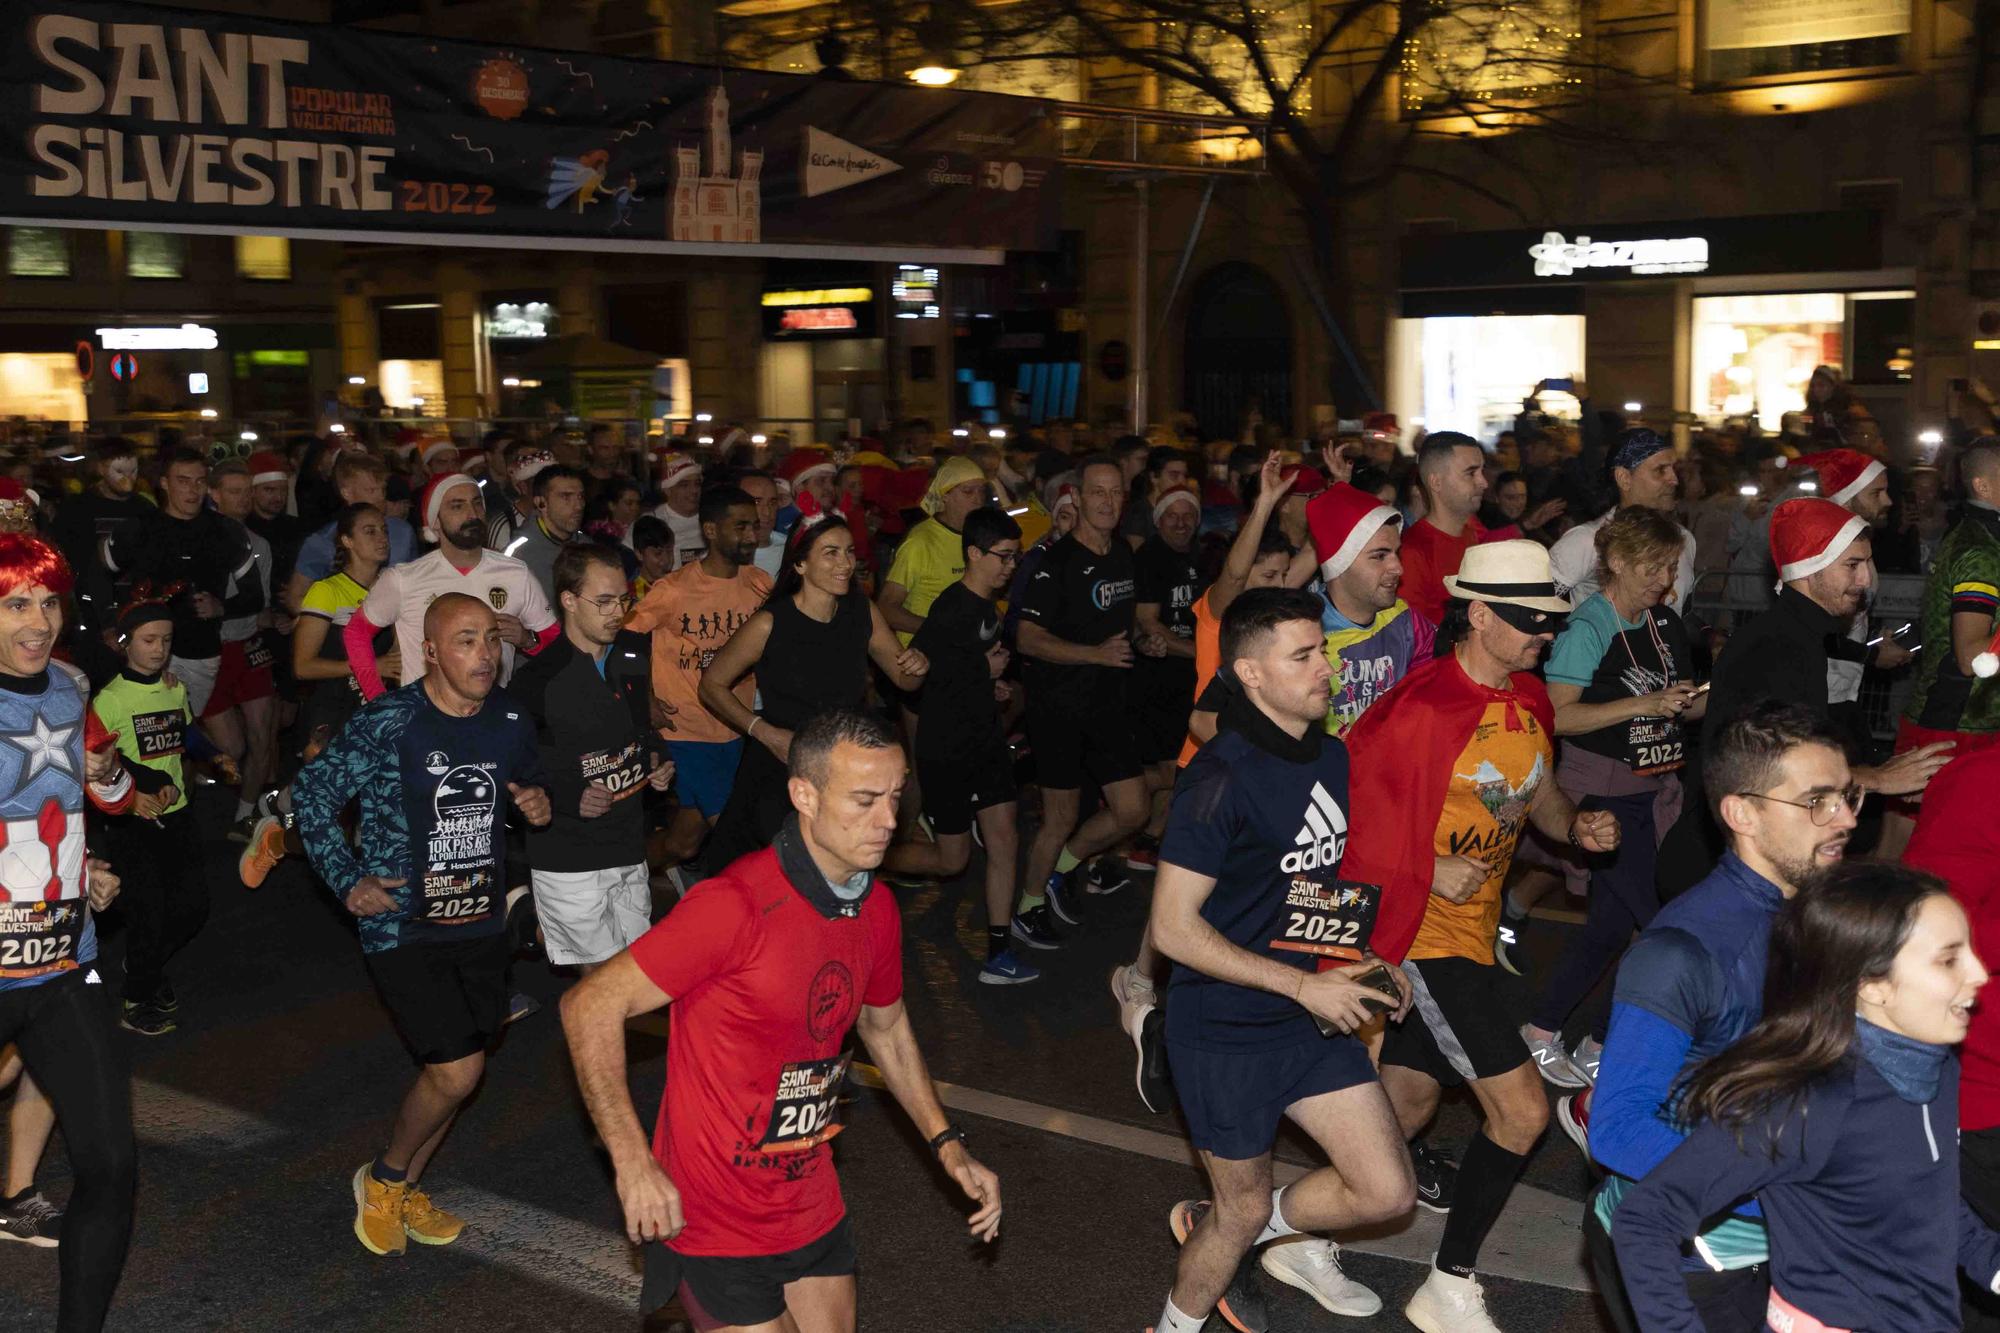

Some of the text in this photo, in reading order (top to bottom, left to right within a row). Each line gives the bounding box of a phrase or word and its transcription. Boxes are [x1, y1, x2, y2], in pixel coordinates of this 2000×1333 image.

[36, 14, 309, 129] SANT
[291, 86, 393, 118] POPULAR
[293, 111, 396, 137] VALENCIANA
[403, 180, 496, 215] 2022
[1339, 655, 1393, 685] JUMP
[1362, 682, 1372, 697] &
[144, 731, 182, 752] 2022
[1629, 724, 1653, 737] SANT
[582, 754, 608, 769] SANT
[1637, 742, 1683, 767] 2022
[592, 763, 644, 792] 022
[427, 838, 451, 855] 10K
[453, 836, 473, 852] PAS
[438, 851, 457, 861] PORT
[1280, 834, 1347, 873] adida
[424, 875, 455, 888] SANT
[1289, 880, 1322, 897] SANT
[426, 896, 490, 917] 2022
[1285, 912, 1360, 944] 2022
[1, 934, 72, 965] 2022
[779, 1068, 812, 1088] SANT
